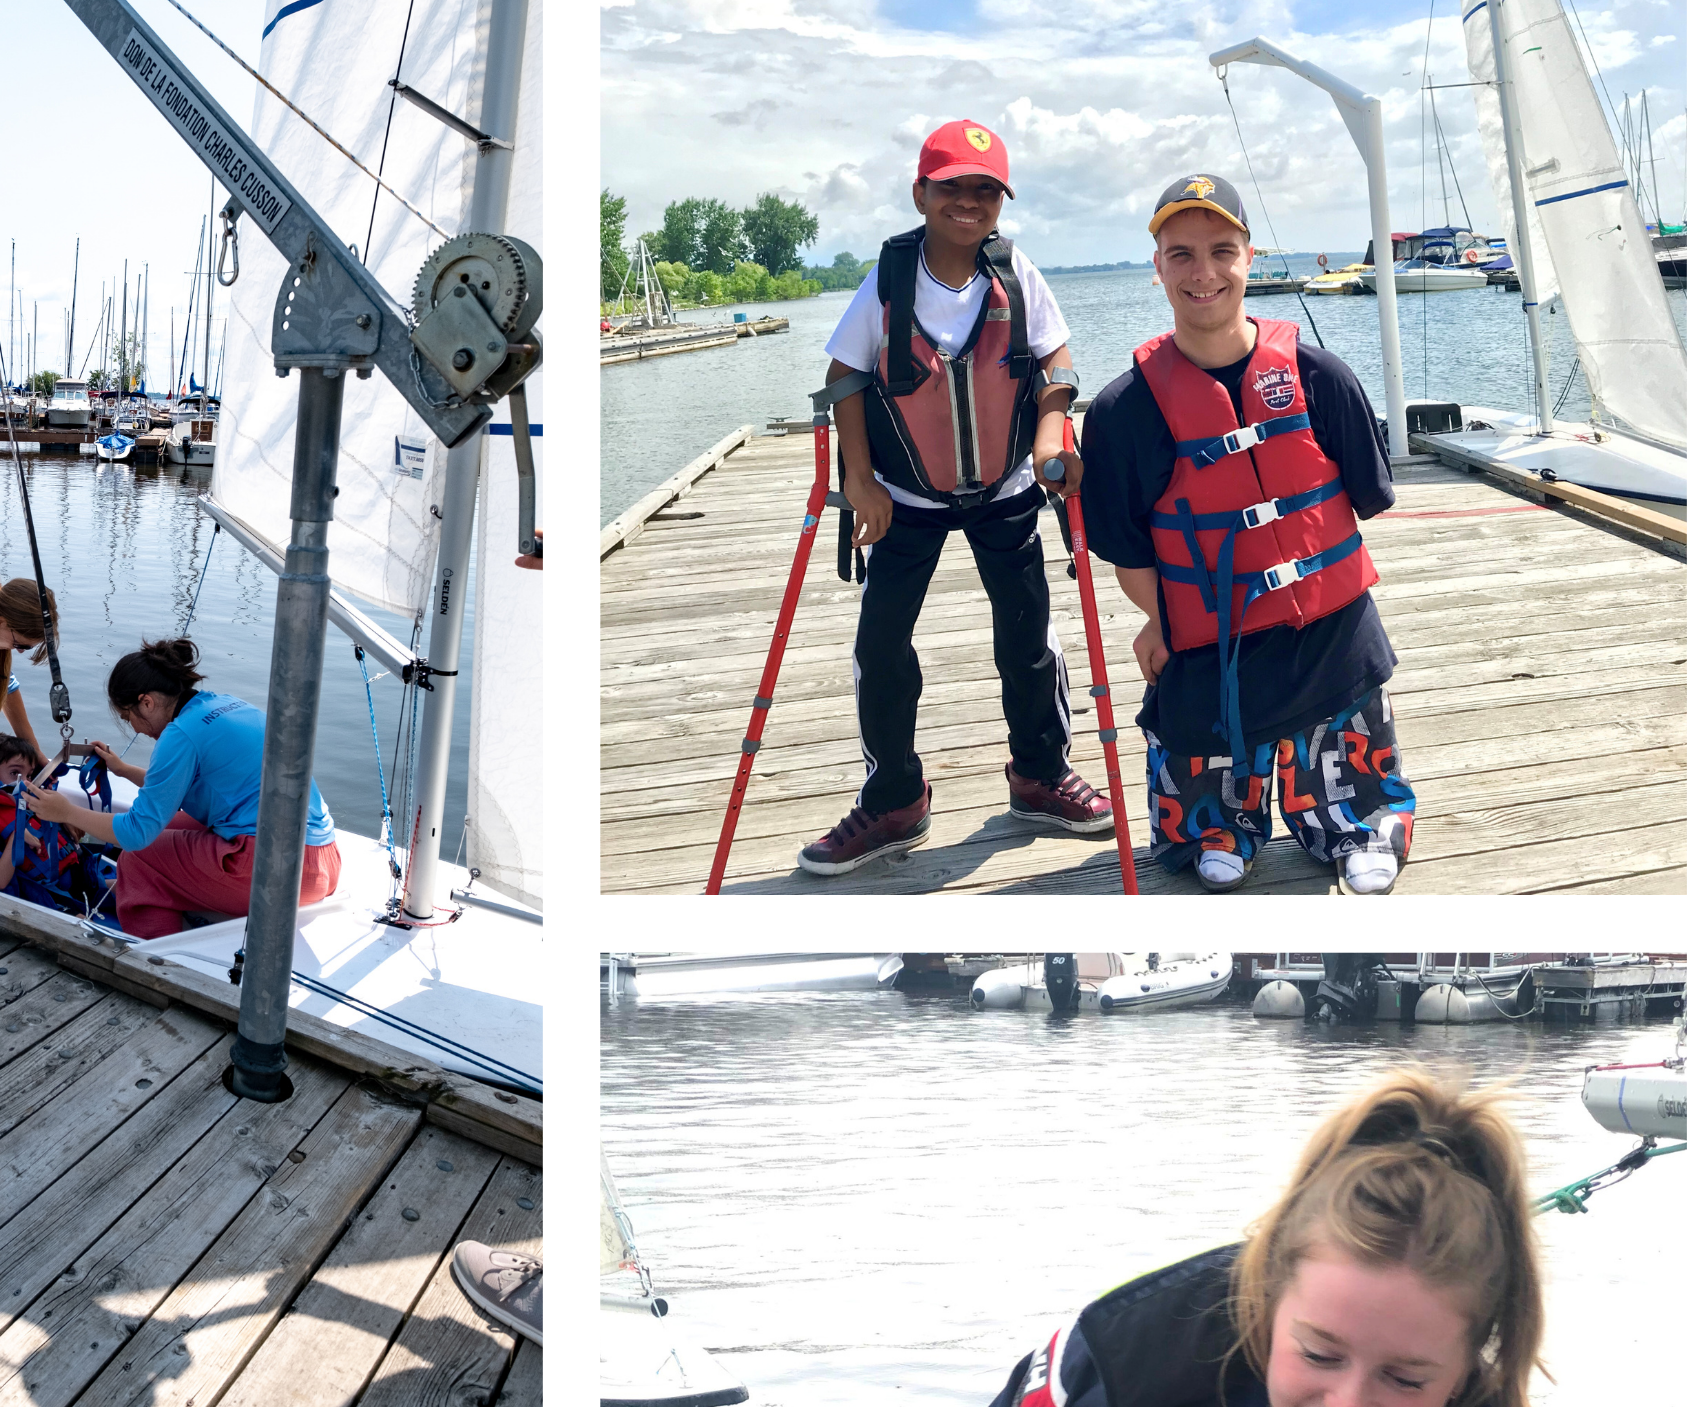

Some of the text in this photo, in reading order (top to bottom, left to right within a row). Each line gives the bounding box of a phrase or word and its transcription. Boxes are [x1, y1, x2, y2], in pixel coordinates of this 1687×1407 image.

[123, 38, 283, 223] DON DE LA FONDATION CHARLES CUSSON
[1052, 956, 1065, 965] 50
